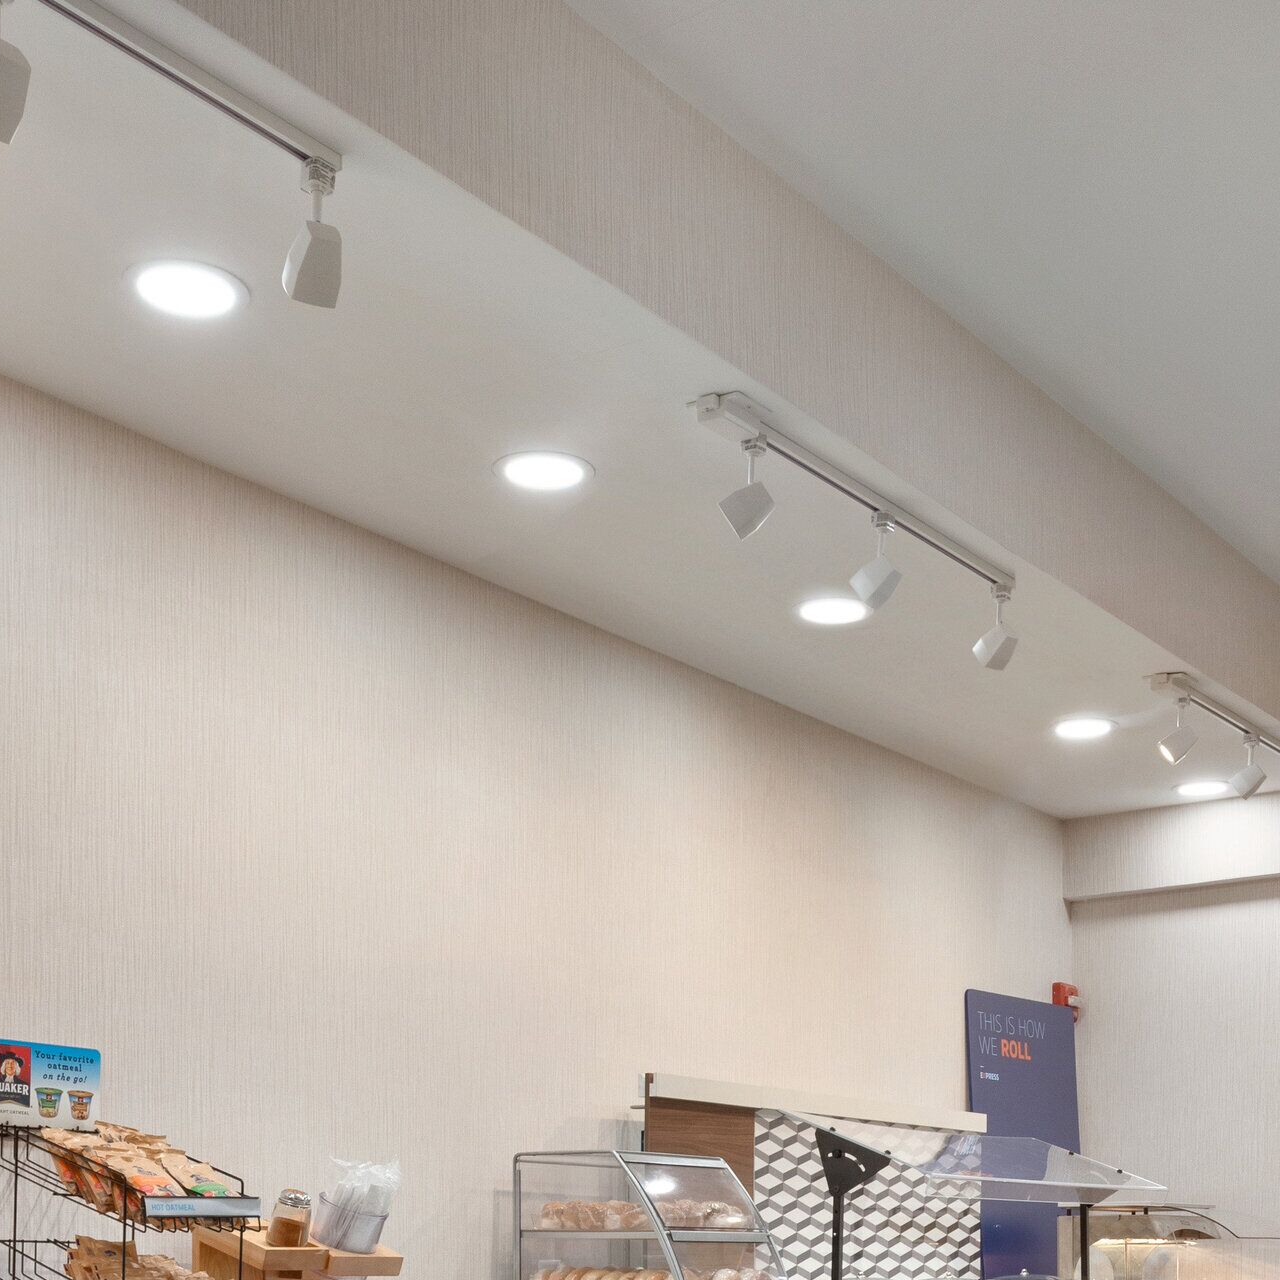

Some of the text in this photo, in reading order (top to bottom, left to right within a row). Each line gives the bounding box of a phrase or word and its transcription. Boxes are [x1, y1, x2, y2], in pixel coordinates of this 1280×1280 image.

[977, 1010, 1046, 1039] THIS IS HOW
[978, 1035, 1032, 1060] WE ROLL
[35, 1050, 95, 1065] Your favorite
[47, 1062, 82, 1072] oatmeal
[56, 1073, 71, 1082] the
[73, 1075, 88, 1084] go!
[980, 1071, 1000, 1081] EXPRESS
[151, 1203, 196, 1212] HOT OATMEAL
